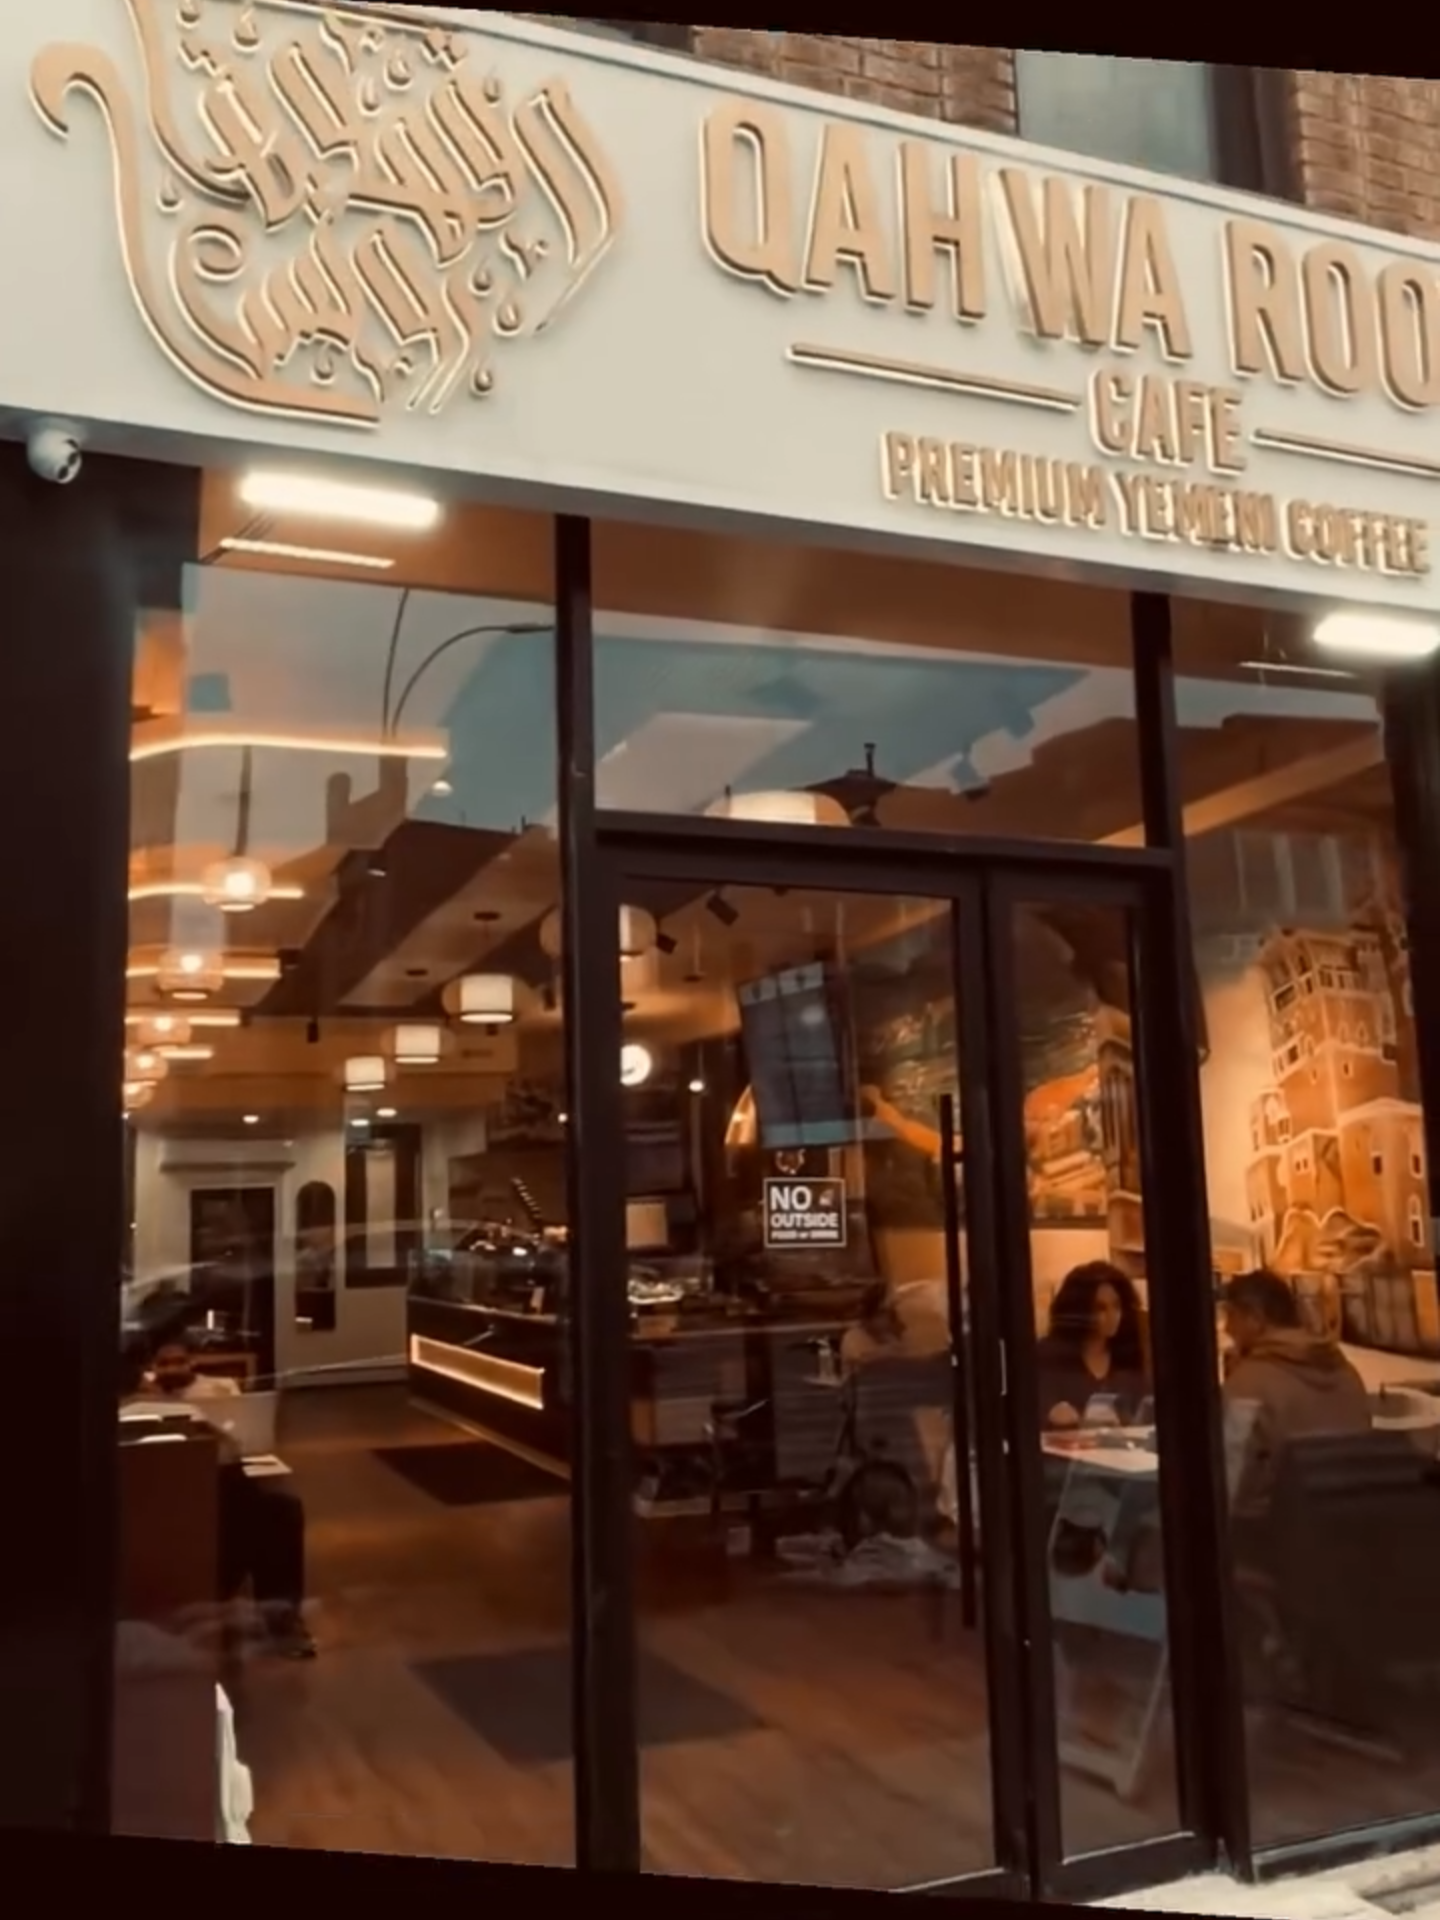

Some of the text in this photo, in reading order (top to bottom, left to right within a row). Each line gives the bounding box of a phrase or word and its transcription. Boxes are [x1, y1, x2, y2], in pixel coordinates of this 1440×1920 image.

[701, 102, 1192, 362] QAHWA
[1088, 368, 1246, 475] CAFE
[880, 430, 1430, 578] PREMIUM YEMENI COFFEE
[770, 1186, 812, 1211] NO
[771, 1213, 839, 1228] OUTSIDE
